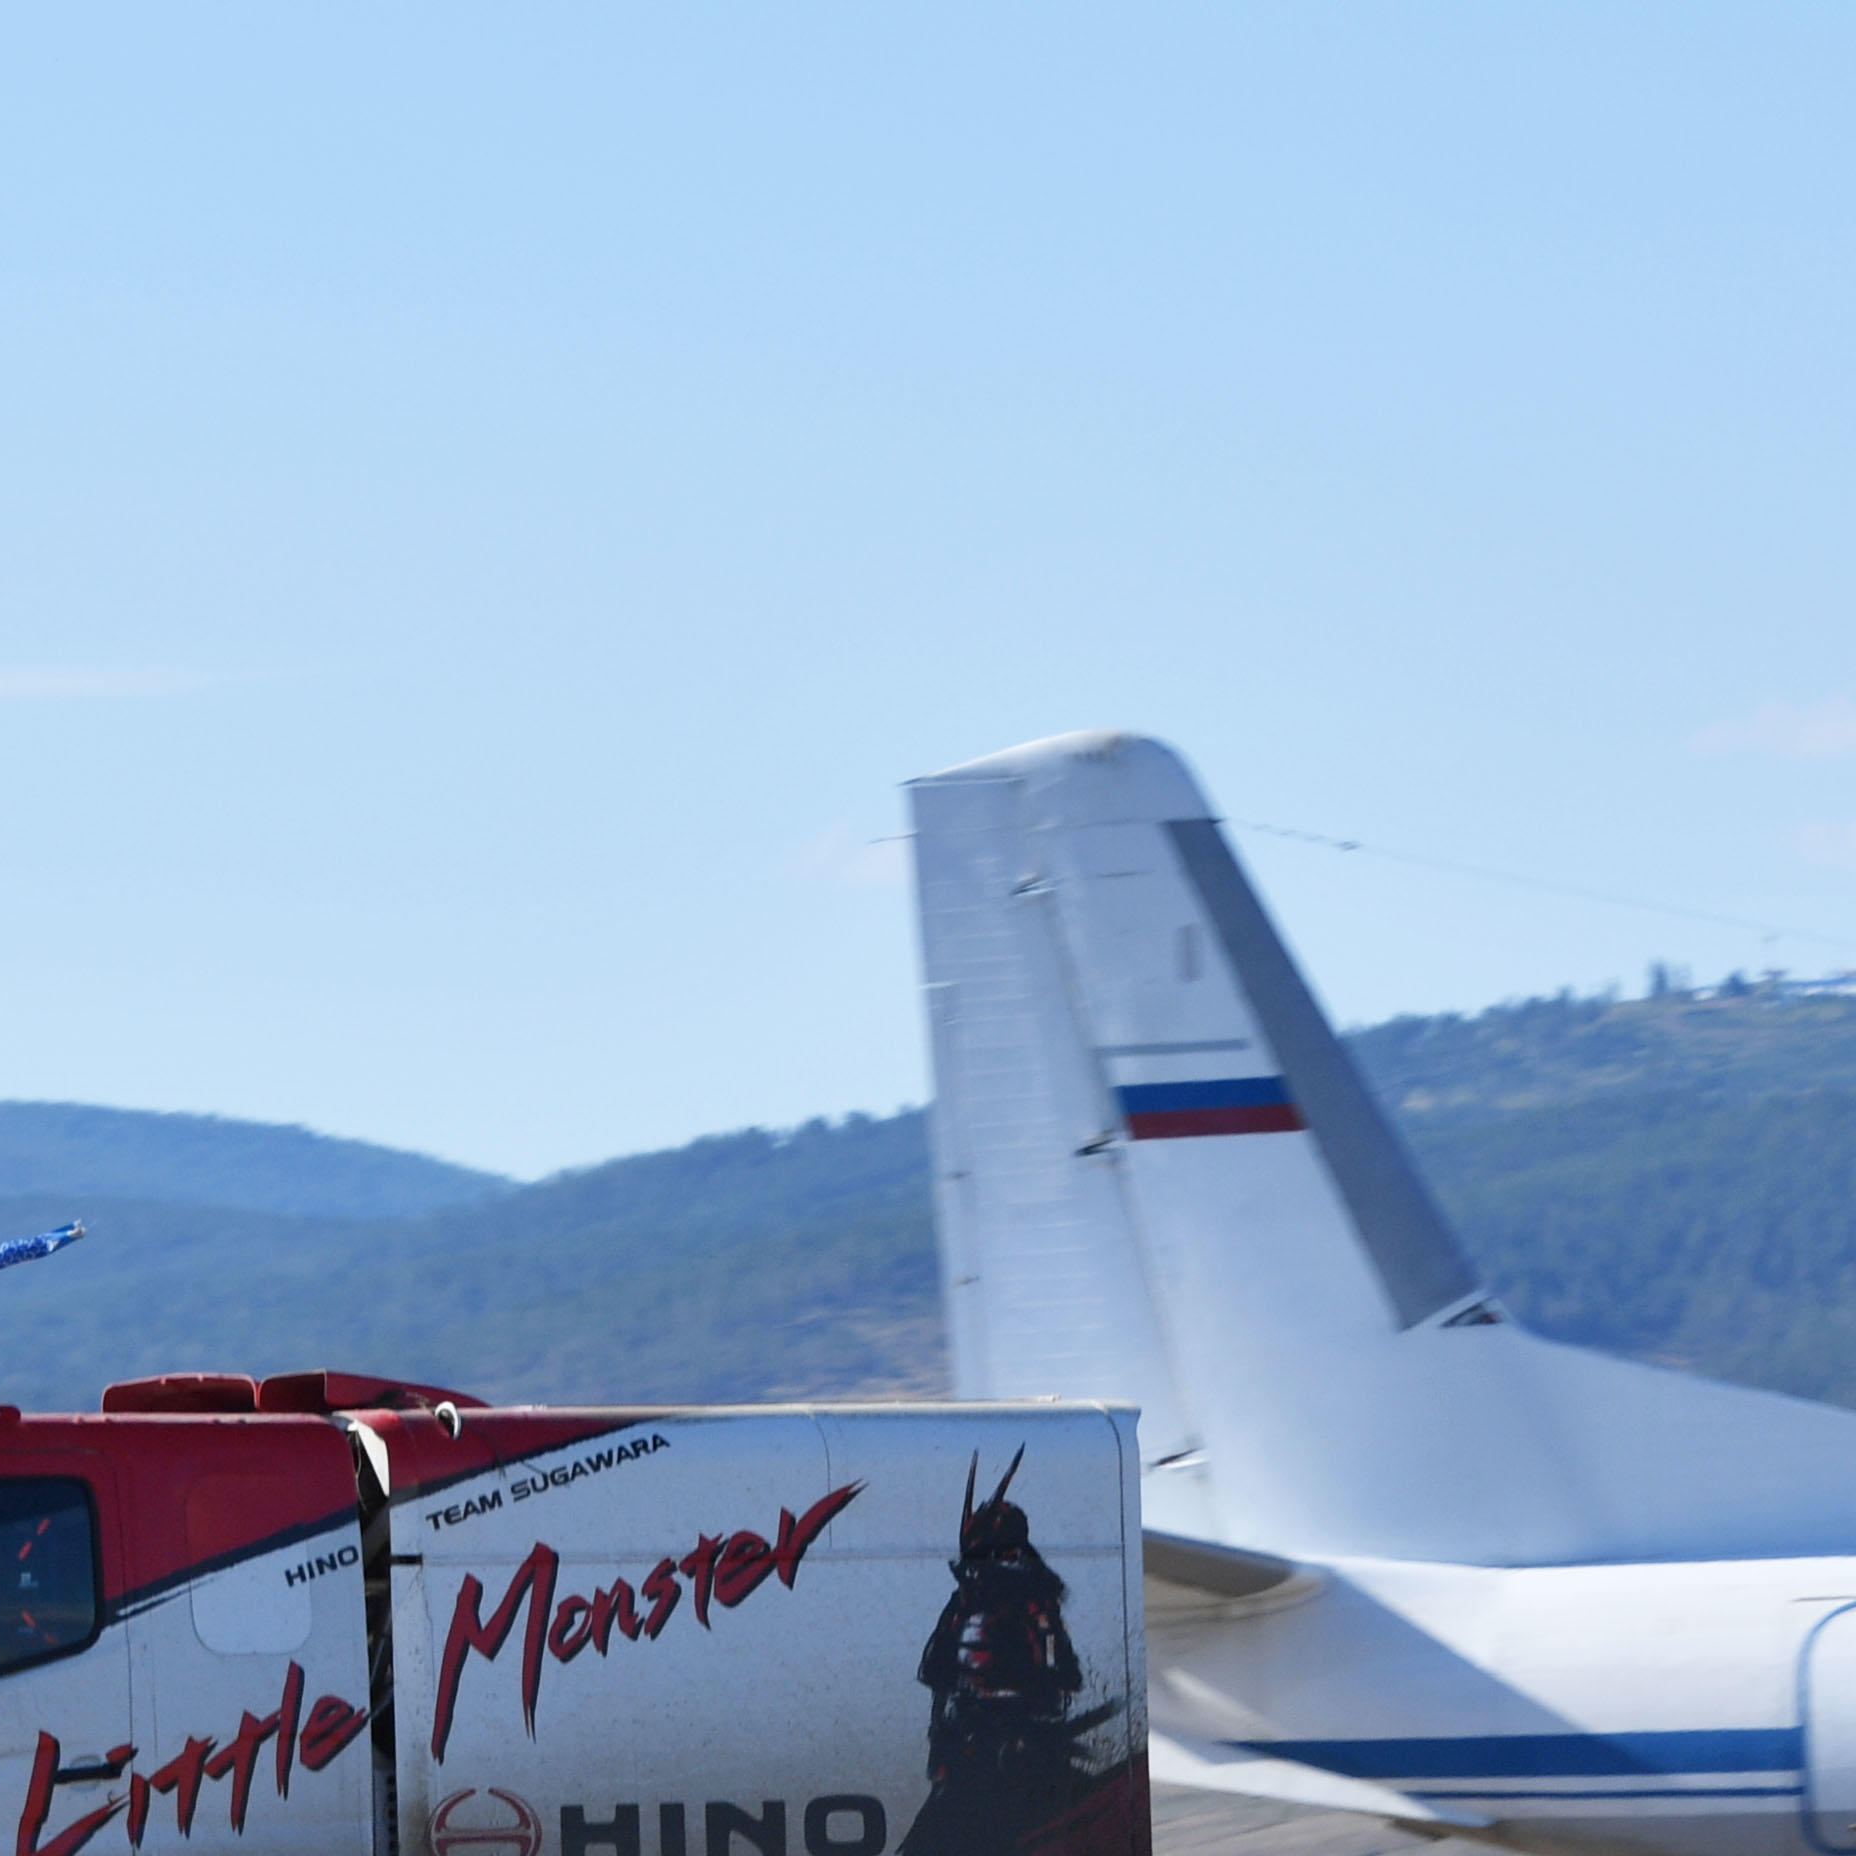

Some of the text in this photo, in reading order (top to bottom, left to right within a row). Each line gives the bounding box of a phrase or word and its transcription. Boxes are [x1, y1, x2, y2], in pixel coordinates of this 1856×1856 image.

[284, 1432, 671, 1588] HINO TEAM SUGAWARA
[431, 1479, 870, 1767] Monster
